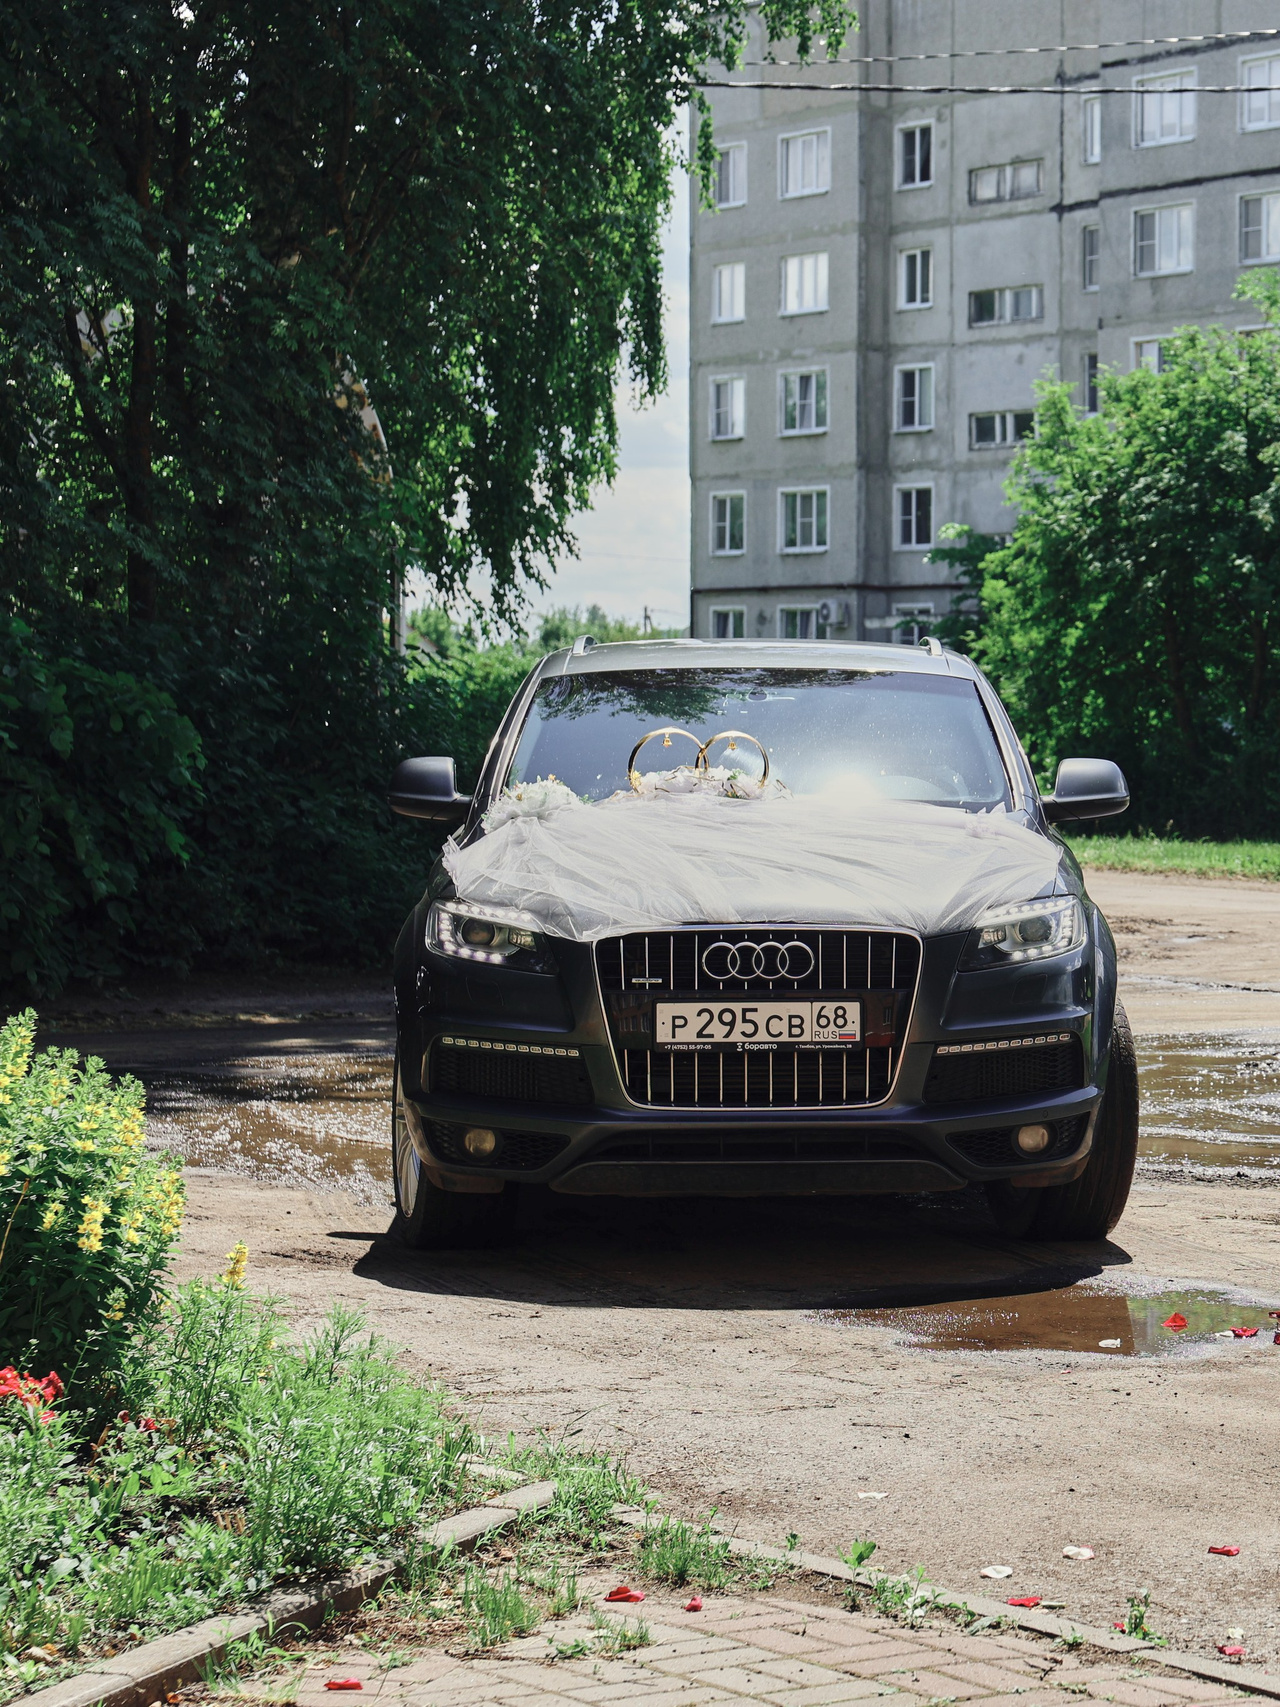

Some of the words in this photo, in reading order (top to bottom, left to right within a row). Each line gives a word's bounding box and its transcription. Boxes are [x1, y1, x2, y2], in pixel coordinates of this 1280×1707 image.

[816, 1005, 848, 1029] 68
[814, 1030, 838, 1040] RUS
[744, 1042, 778, 1051] боравто
